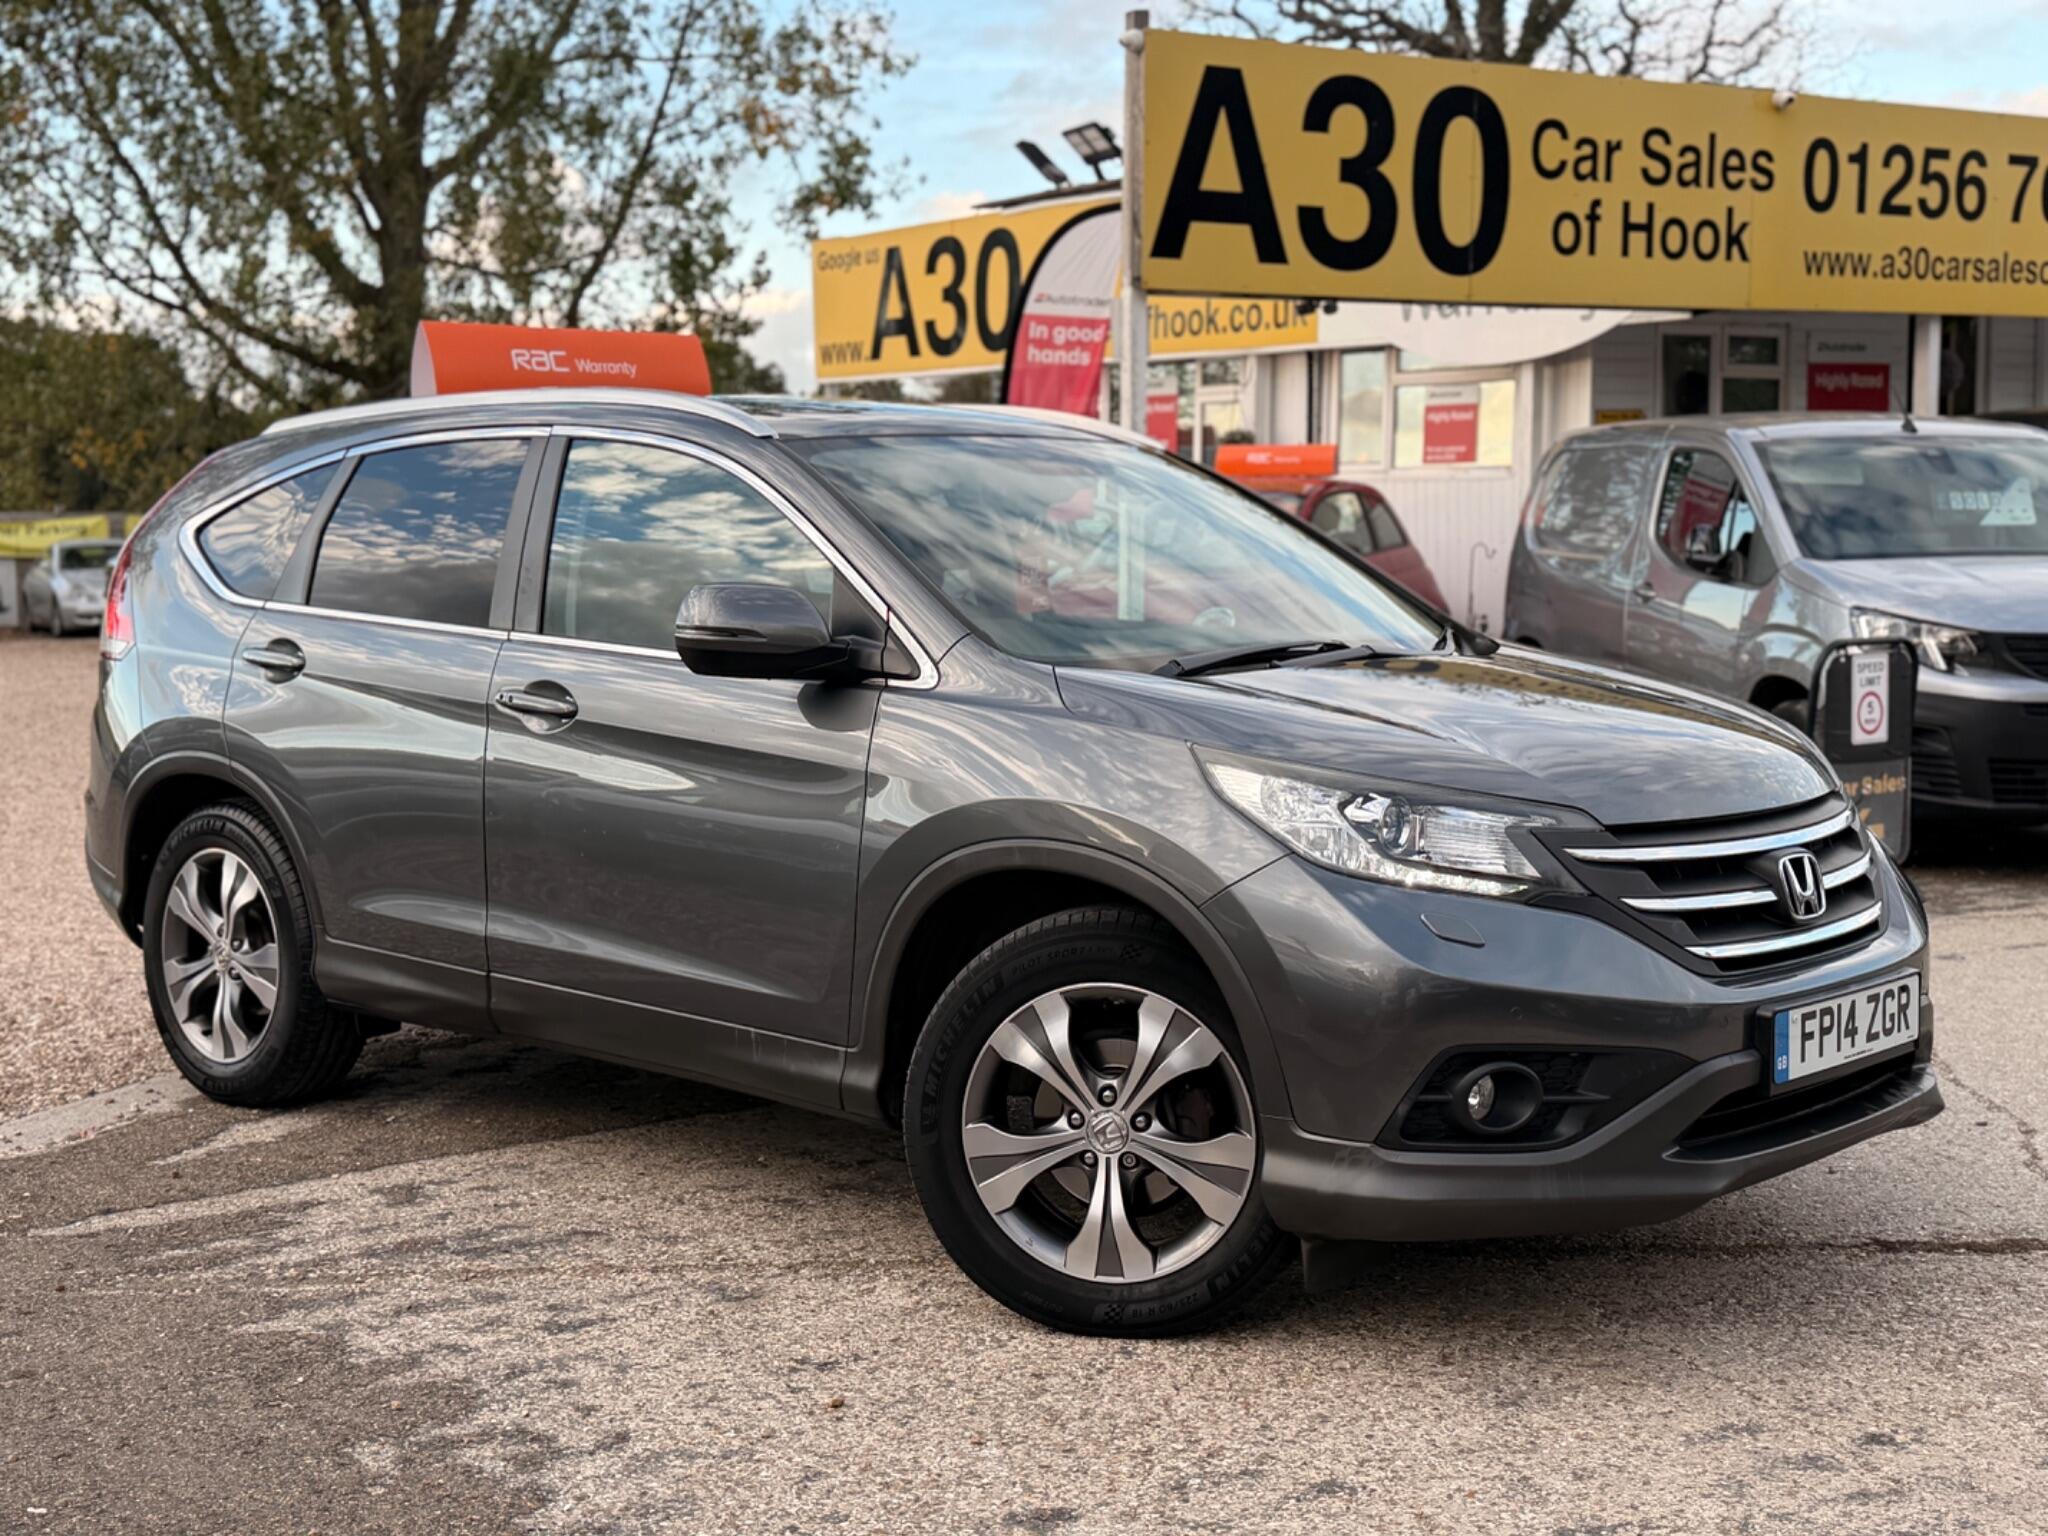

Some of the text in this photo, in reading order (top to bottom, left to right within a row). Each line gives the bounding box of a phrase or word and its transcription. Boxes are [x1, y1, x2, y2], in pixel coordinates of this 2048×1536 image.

[1532, 118, 1776, 192] Car Sales
[1150, 65, 1510, 276] A30
[1803, 137, 2048, 223] 01256 7
[1552, 199, 1750, 263] of Hook
[818, 249, 862, 272] Google
[1028, 321, 1104, 344] In good
[1028, 344, 1091, 366] hands
[574, 358, 637, 378] Warranty
[1857, 662, 1885, 673] SPEED
[1867, 701, 1874, 715] 5
[1801, 984, 1911, 1063] FP14 ZGR
